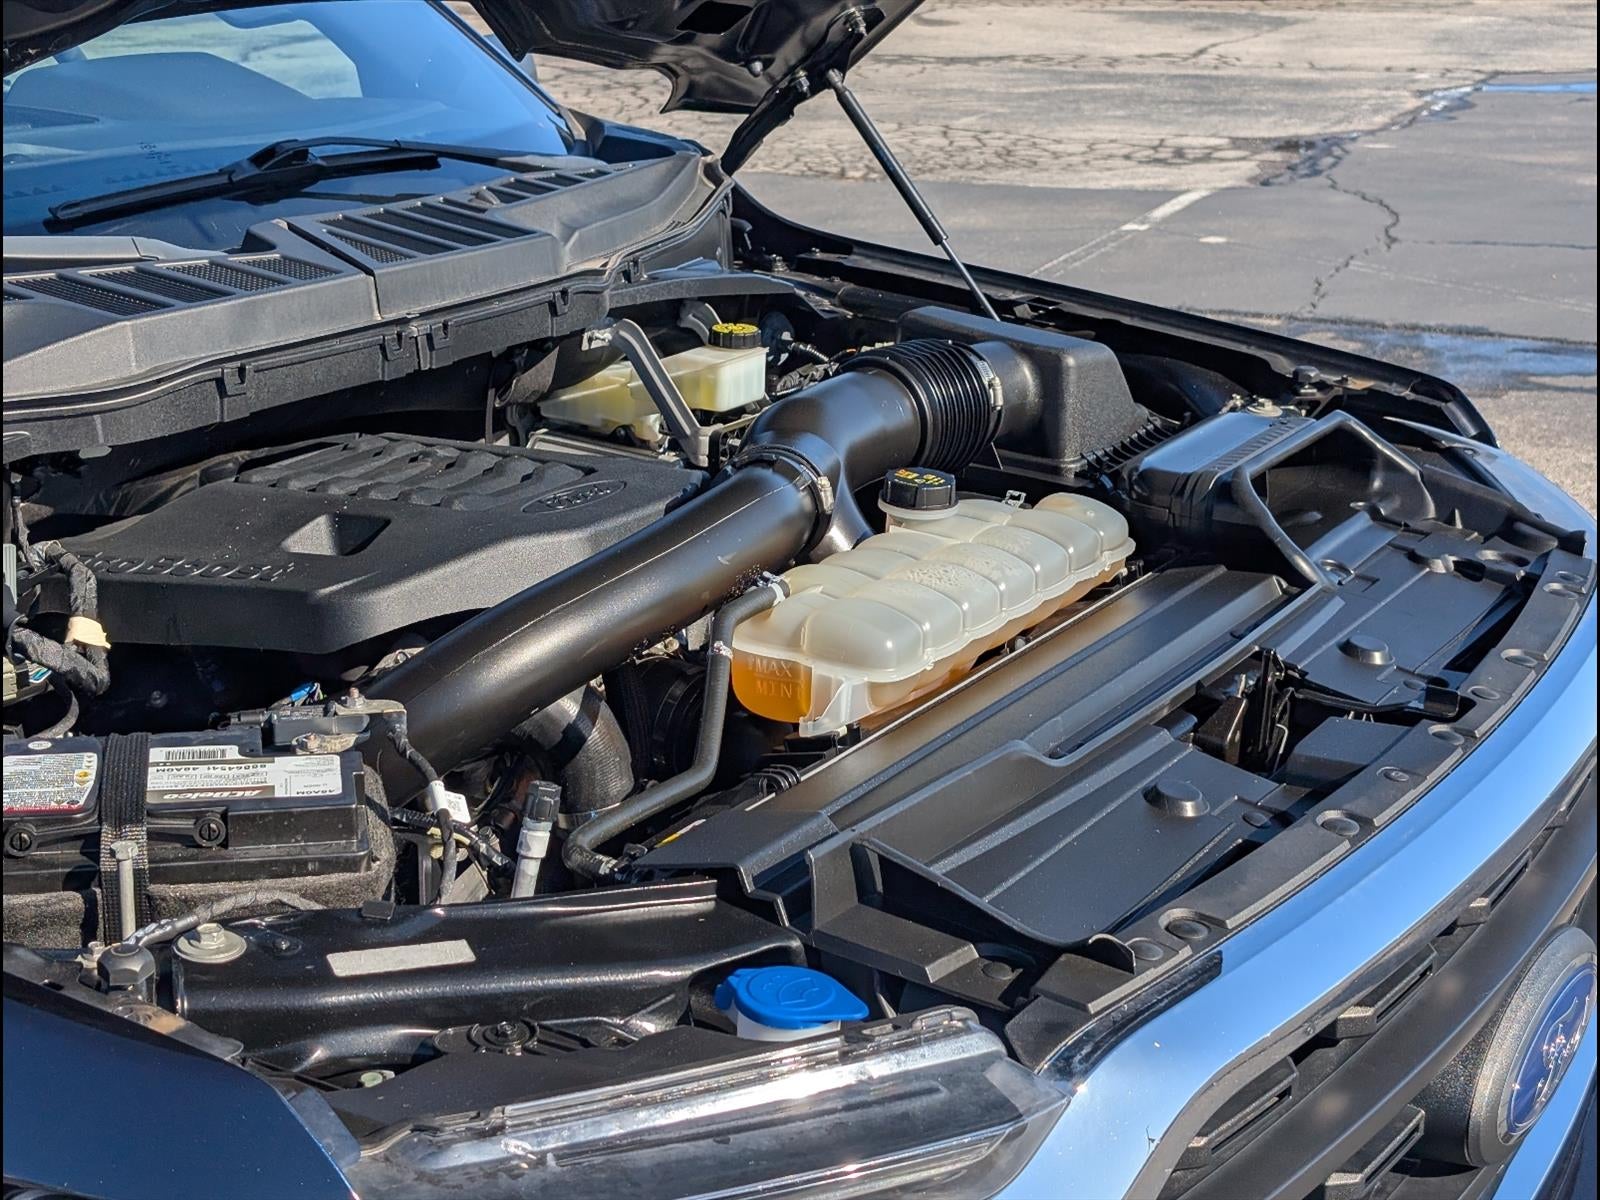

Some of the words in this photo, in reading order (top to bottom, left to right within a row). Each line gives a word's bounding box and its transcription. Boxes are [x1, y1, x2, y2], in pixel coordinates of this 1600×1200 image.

[755, 657, 792, 677] MAX
[756, 680, 793, 698] MIN
[163, 789, 262, 800] ACDelco
